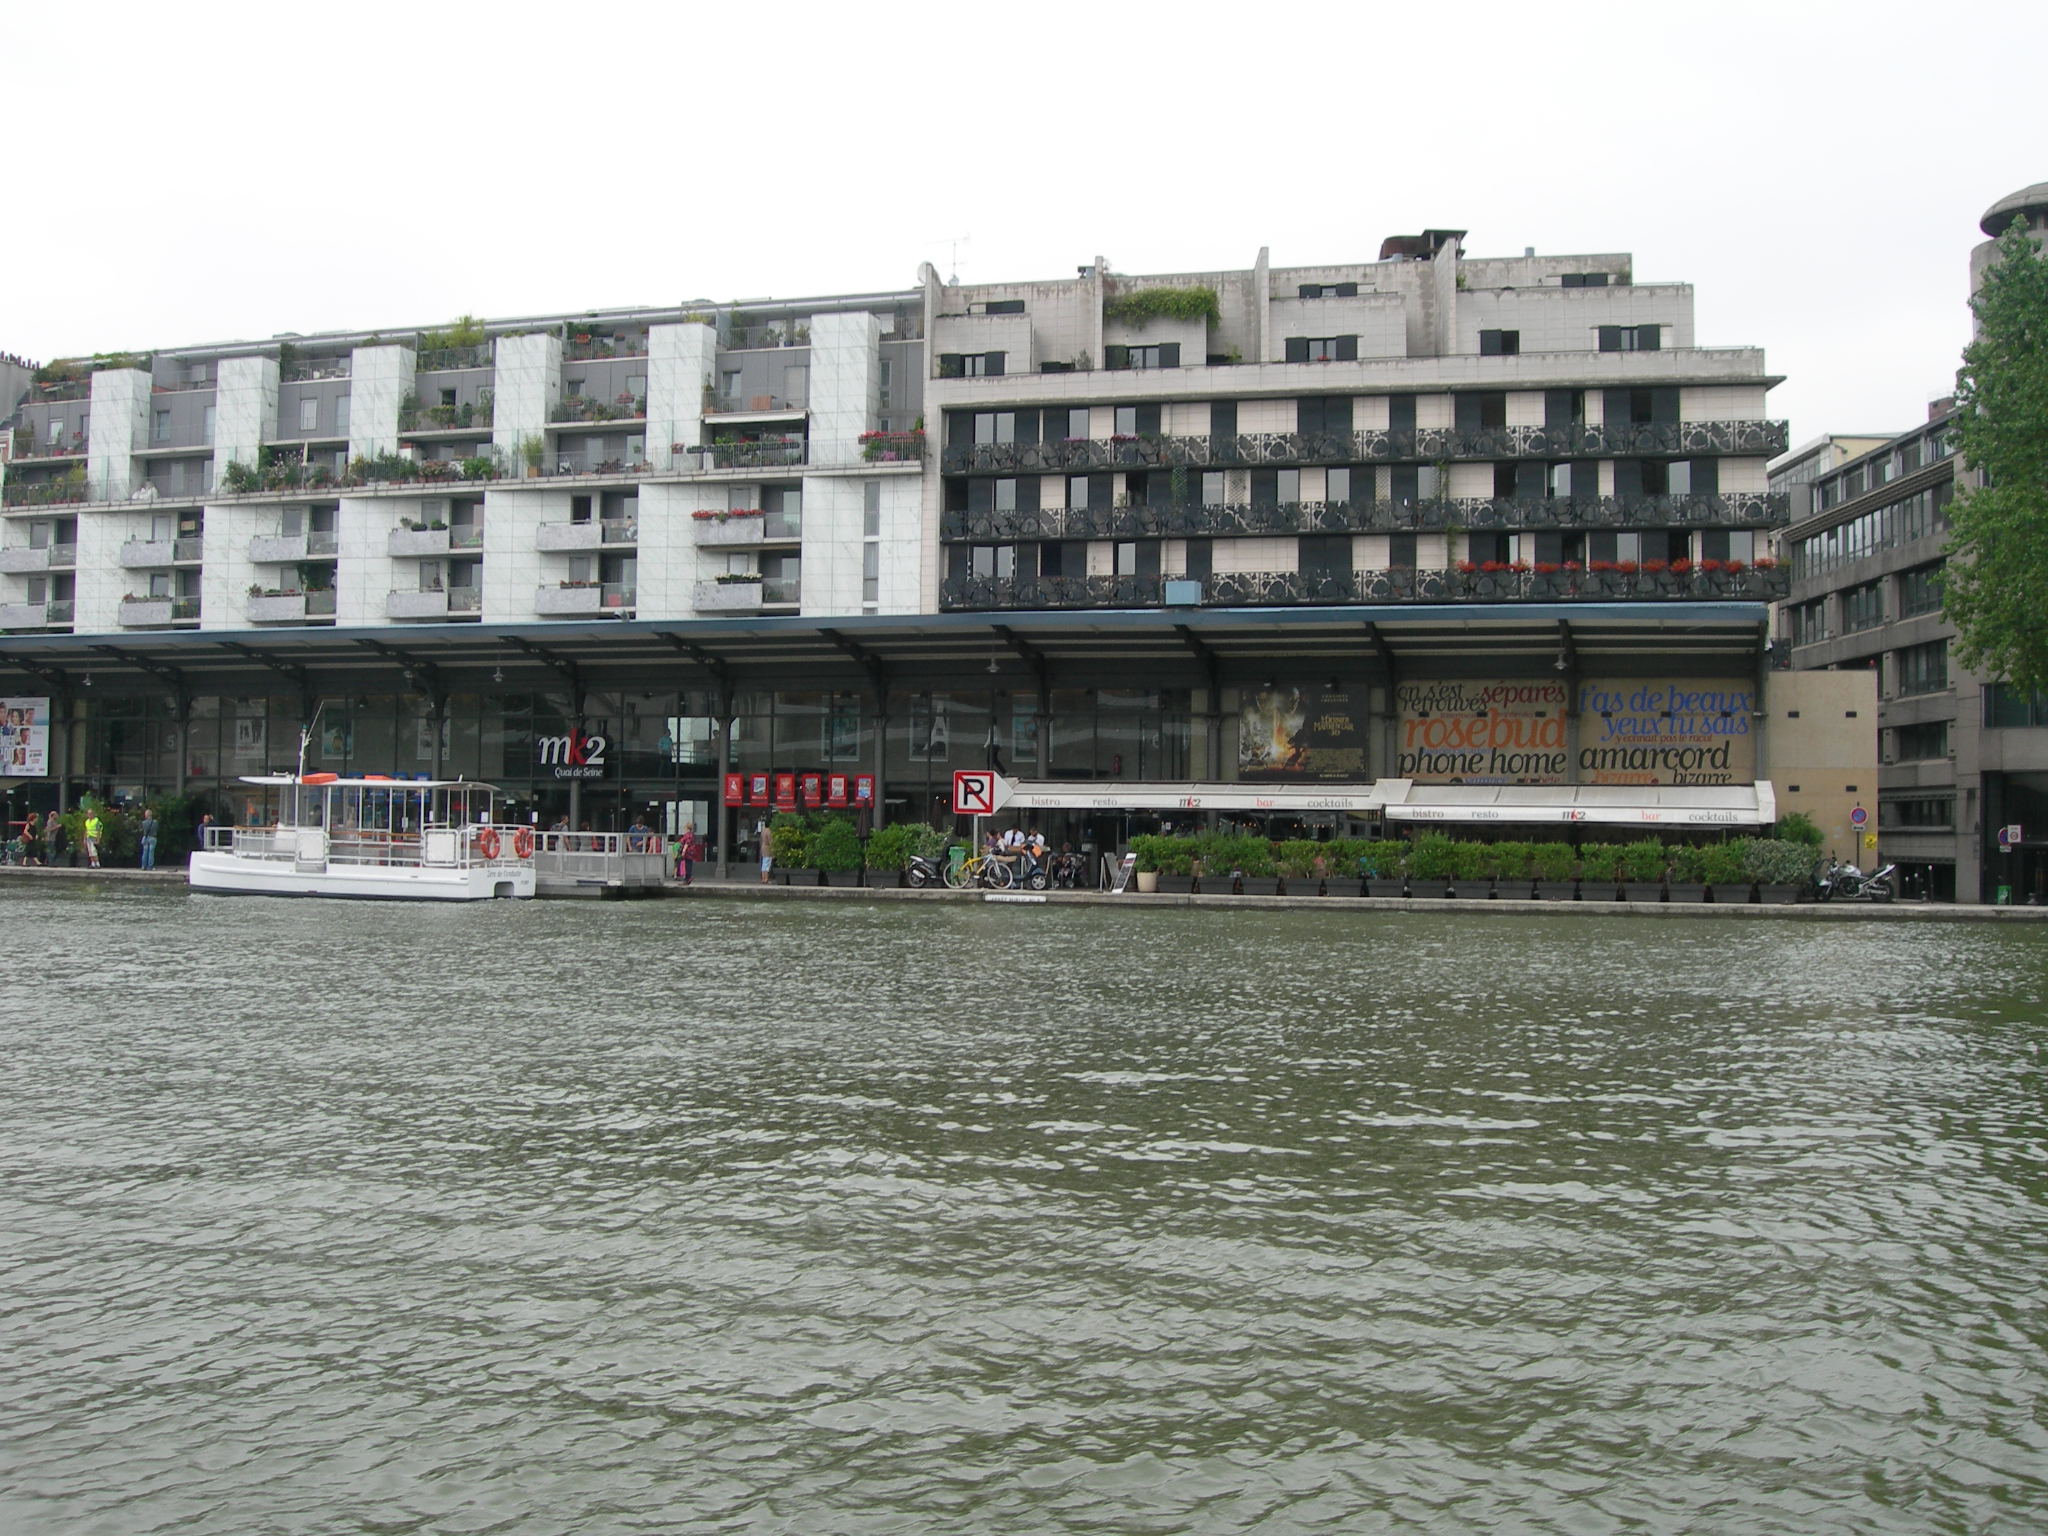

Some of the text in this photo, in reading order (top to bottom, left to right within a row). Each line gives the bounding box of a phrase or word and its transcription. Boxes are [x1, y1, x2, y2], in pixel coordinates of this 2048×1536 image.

[1403, 693, 1488, 712] retrouvés
[1482, 681, 1567, 709] séparés
[1579, 684, 1754, 713] t'as de beaux
[1404, 707, 1569, 748] rosebud
[1600, 713, 1749, 742] yeux tu sais
[538, 728, 606, 765] mk2
[1579, 740, 1731, 770] amarcord
[573, 767, 582, 777] de
[583, 766, 603, 777] Seine
[1397, 746, 1567, 778] phone home
[1031, 795, 1061, 806] bistro
[1092, 797, 1118, 806] resto
[1256, 797, 1275, 807] bar
[1307, 797, 1354, 809] cocktails
[1412, 807, 1445, 819] bistro
[1471, 809, 1499, 819] resto
[1641, 810, 1661, 821] bar
[1688, 810, 1738, 822] cocktails
